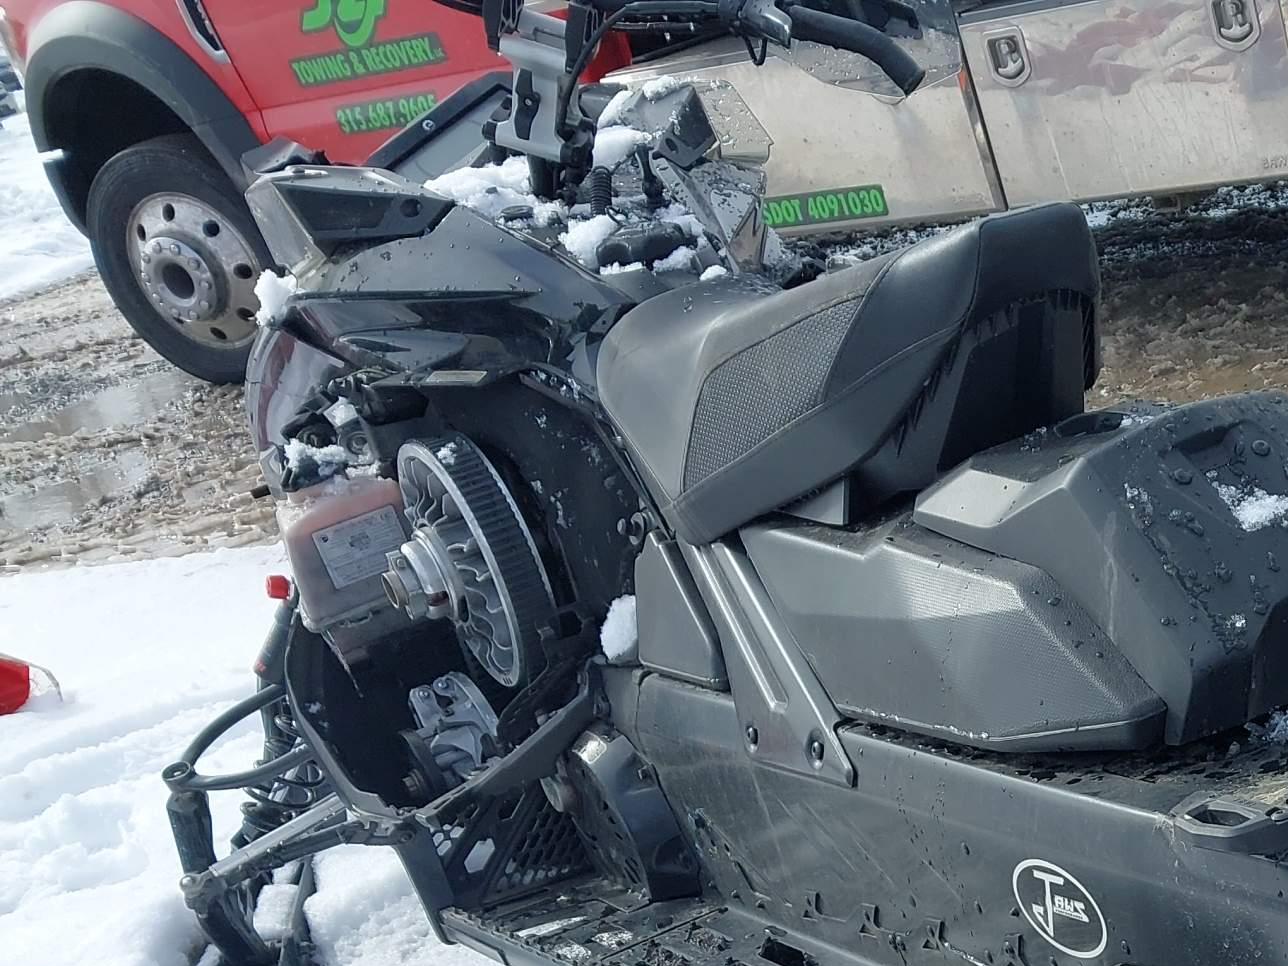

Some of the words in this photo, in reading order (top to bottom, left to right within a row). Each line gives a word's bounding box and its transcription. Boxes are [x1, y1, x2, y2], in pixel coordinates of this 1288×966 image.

[291, 54, 351, 84] TOWING
[349, 51, 366, 74] &
[361, 36, 435, 72] RECOVERY
[808, 189, 884, 219] 4091030
